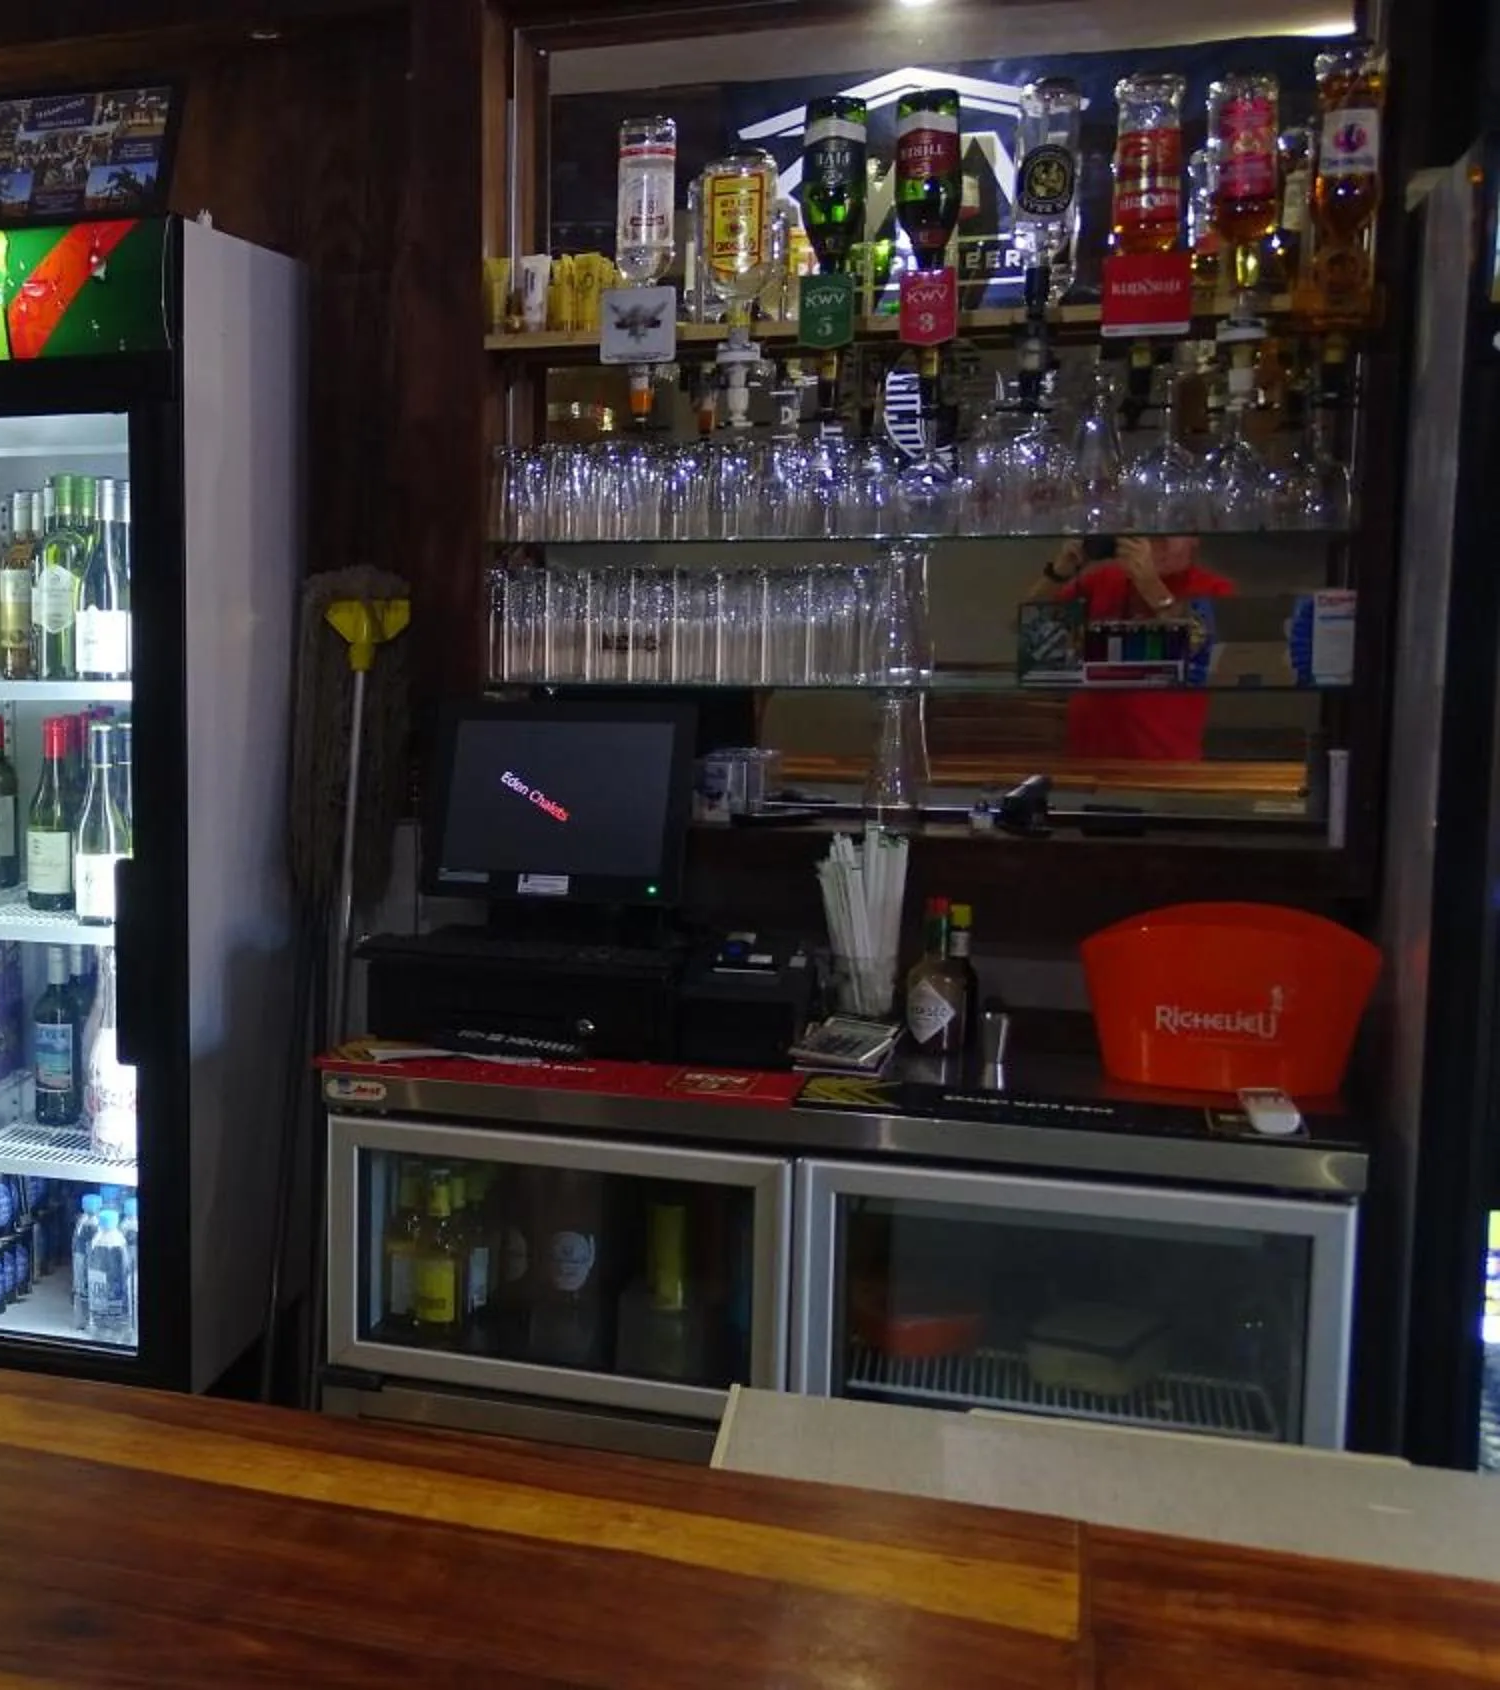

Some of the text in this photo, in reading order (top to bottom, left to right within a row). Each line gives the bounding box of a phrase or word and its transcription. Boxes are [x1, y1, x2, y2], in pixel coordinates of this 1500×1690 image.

[804, 292, 846, 309] KWV
[906, 289, 948, 305] KWV
[818, 316, 833, 337] 5
[918, 312, 936, 333] 3
[501, 771, 528, 795] Eden
